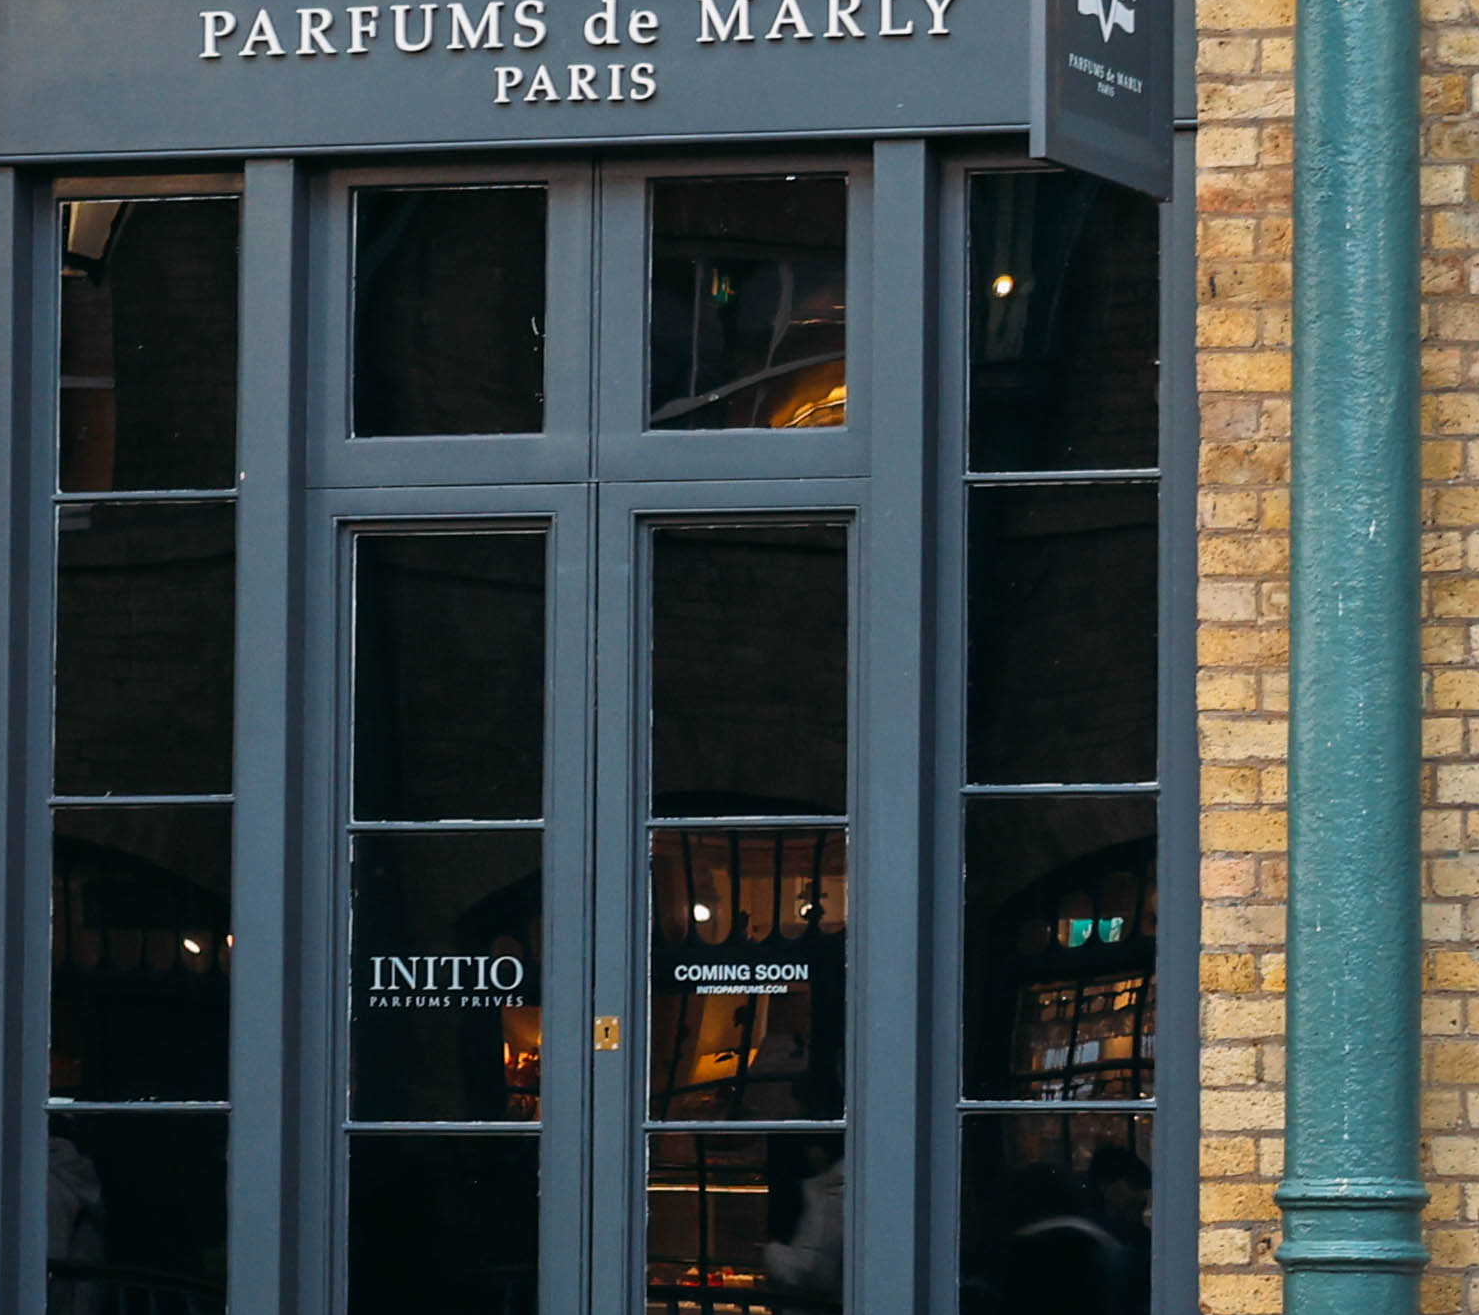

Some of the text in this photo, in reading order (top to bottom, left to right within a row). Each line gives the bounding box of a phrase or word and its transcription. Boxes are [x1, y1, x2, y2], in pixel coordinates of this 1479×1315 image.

[493, 62, 658, 104] PARIS
[1068, 52, 1143, 94] PARFUMS de MARLY
[369, 955, 524, 990] INITIO
[674, 964, 809, 981] COMING SOON
[369, 994, 524, 1007] PARFUMS PRIVÉS
[696, 985, 788, 994] INITIOPARFUMS.COM
